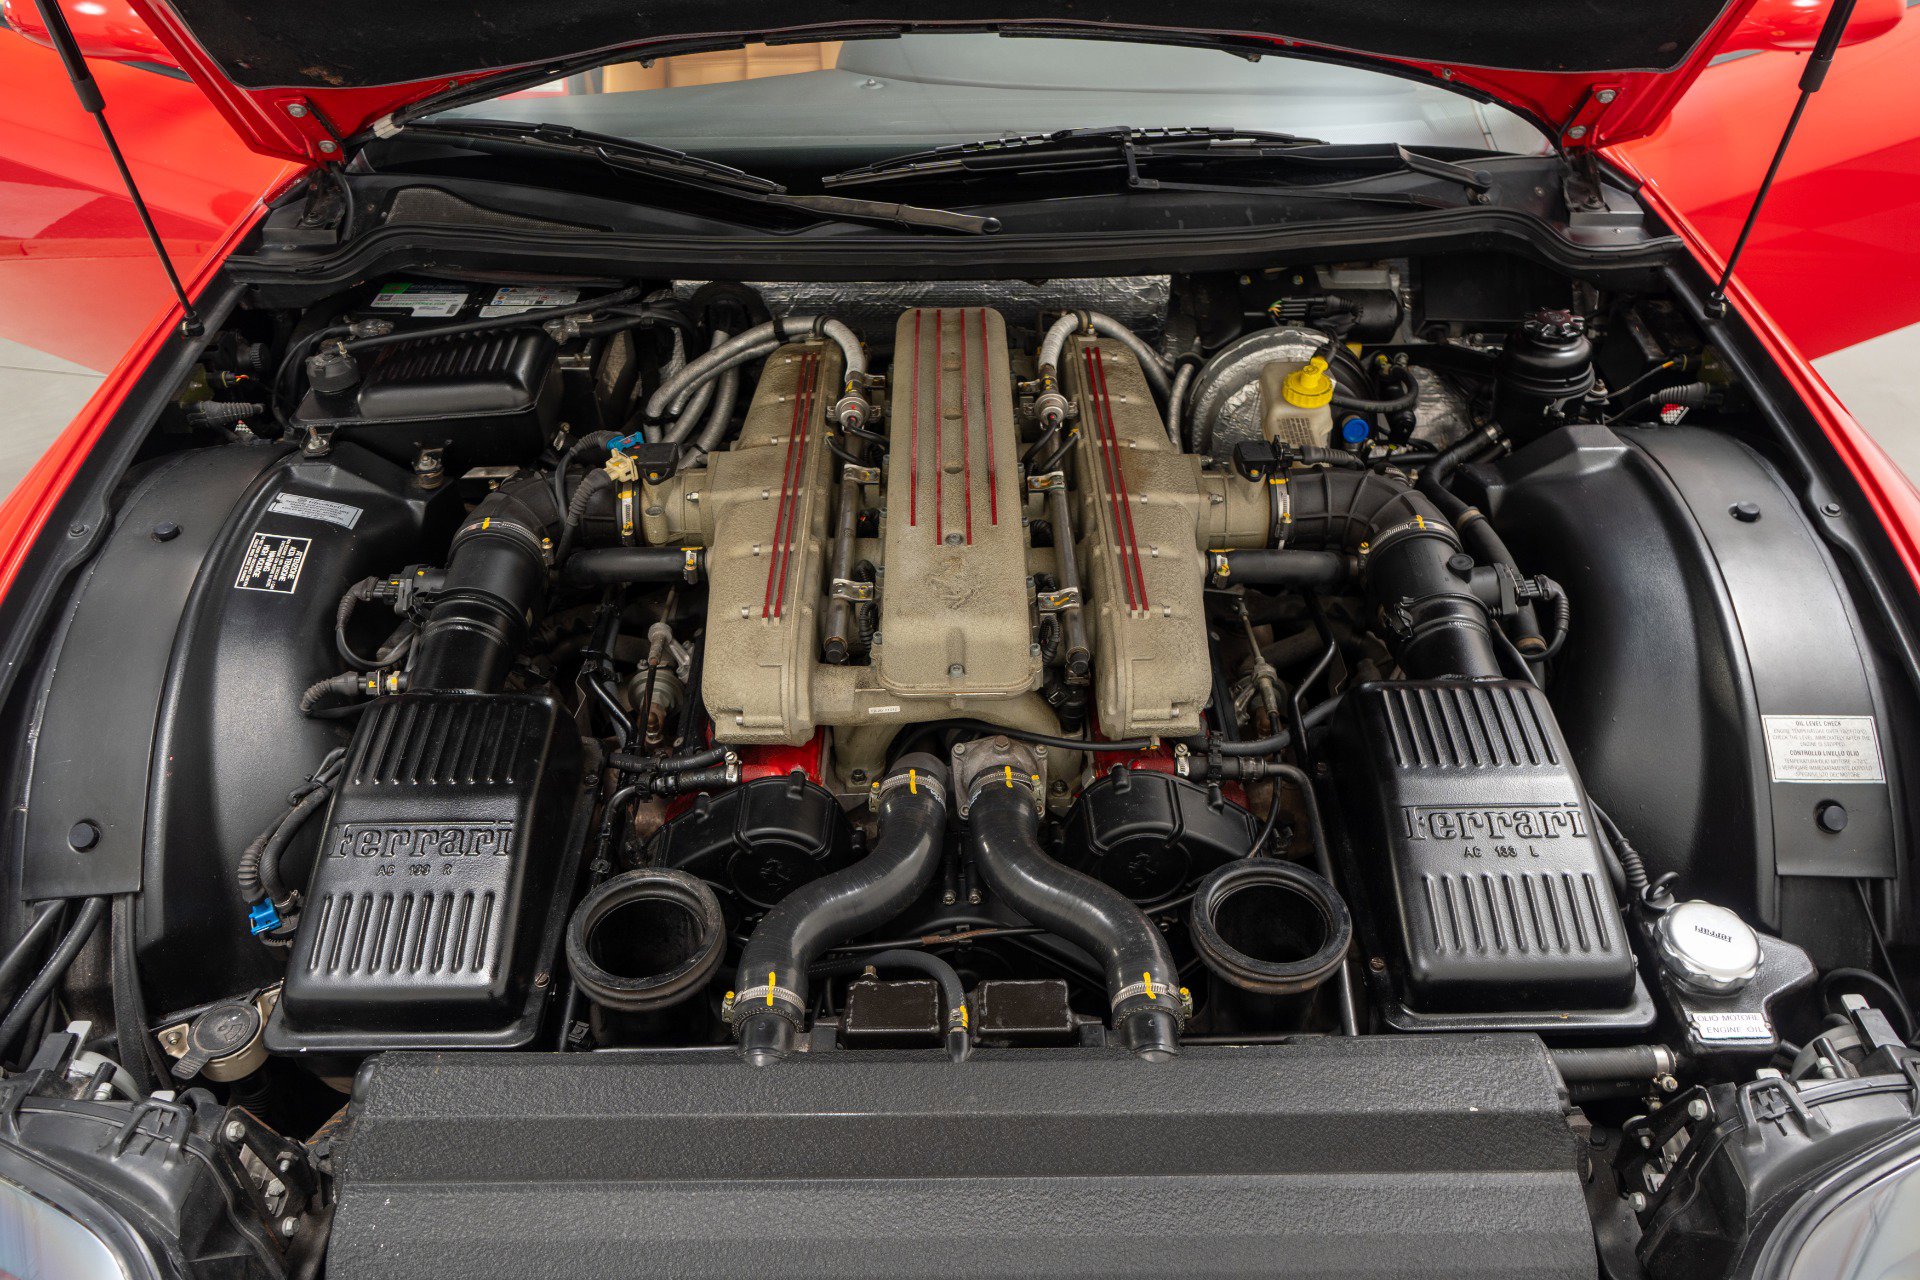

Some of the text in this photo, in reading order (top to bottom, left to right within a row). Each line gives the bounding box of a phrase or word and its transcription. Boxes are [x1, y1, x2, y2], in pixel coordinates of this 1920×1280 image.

[260, 544, 271, 556] HIGH
[252, 557, 266, 578] VOLTAGE
[262, 550, 277, 572] WARNING
[278, 557, 293, 582] TENSIONE
[287, 550, 303, 580] ATTENZIONE
[1401, 802, 1588, 841] Ferrari
[327, 820, 514, 859] Ferrari
[1463, 846, 1483, 858] AC
[1528, 845, 1540, 858] L
[375, 864, 396, 877] AC
[442, 863, 453, 876] R
[1694, 925, 1733, 943] Ferrari
[1696, 1013, 1761, 1022] OLIO MOTORE
[1706, 1026, 1741, 1034] ENGINE
